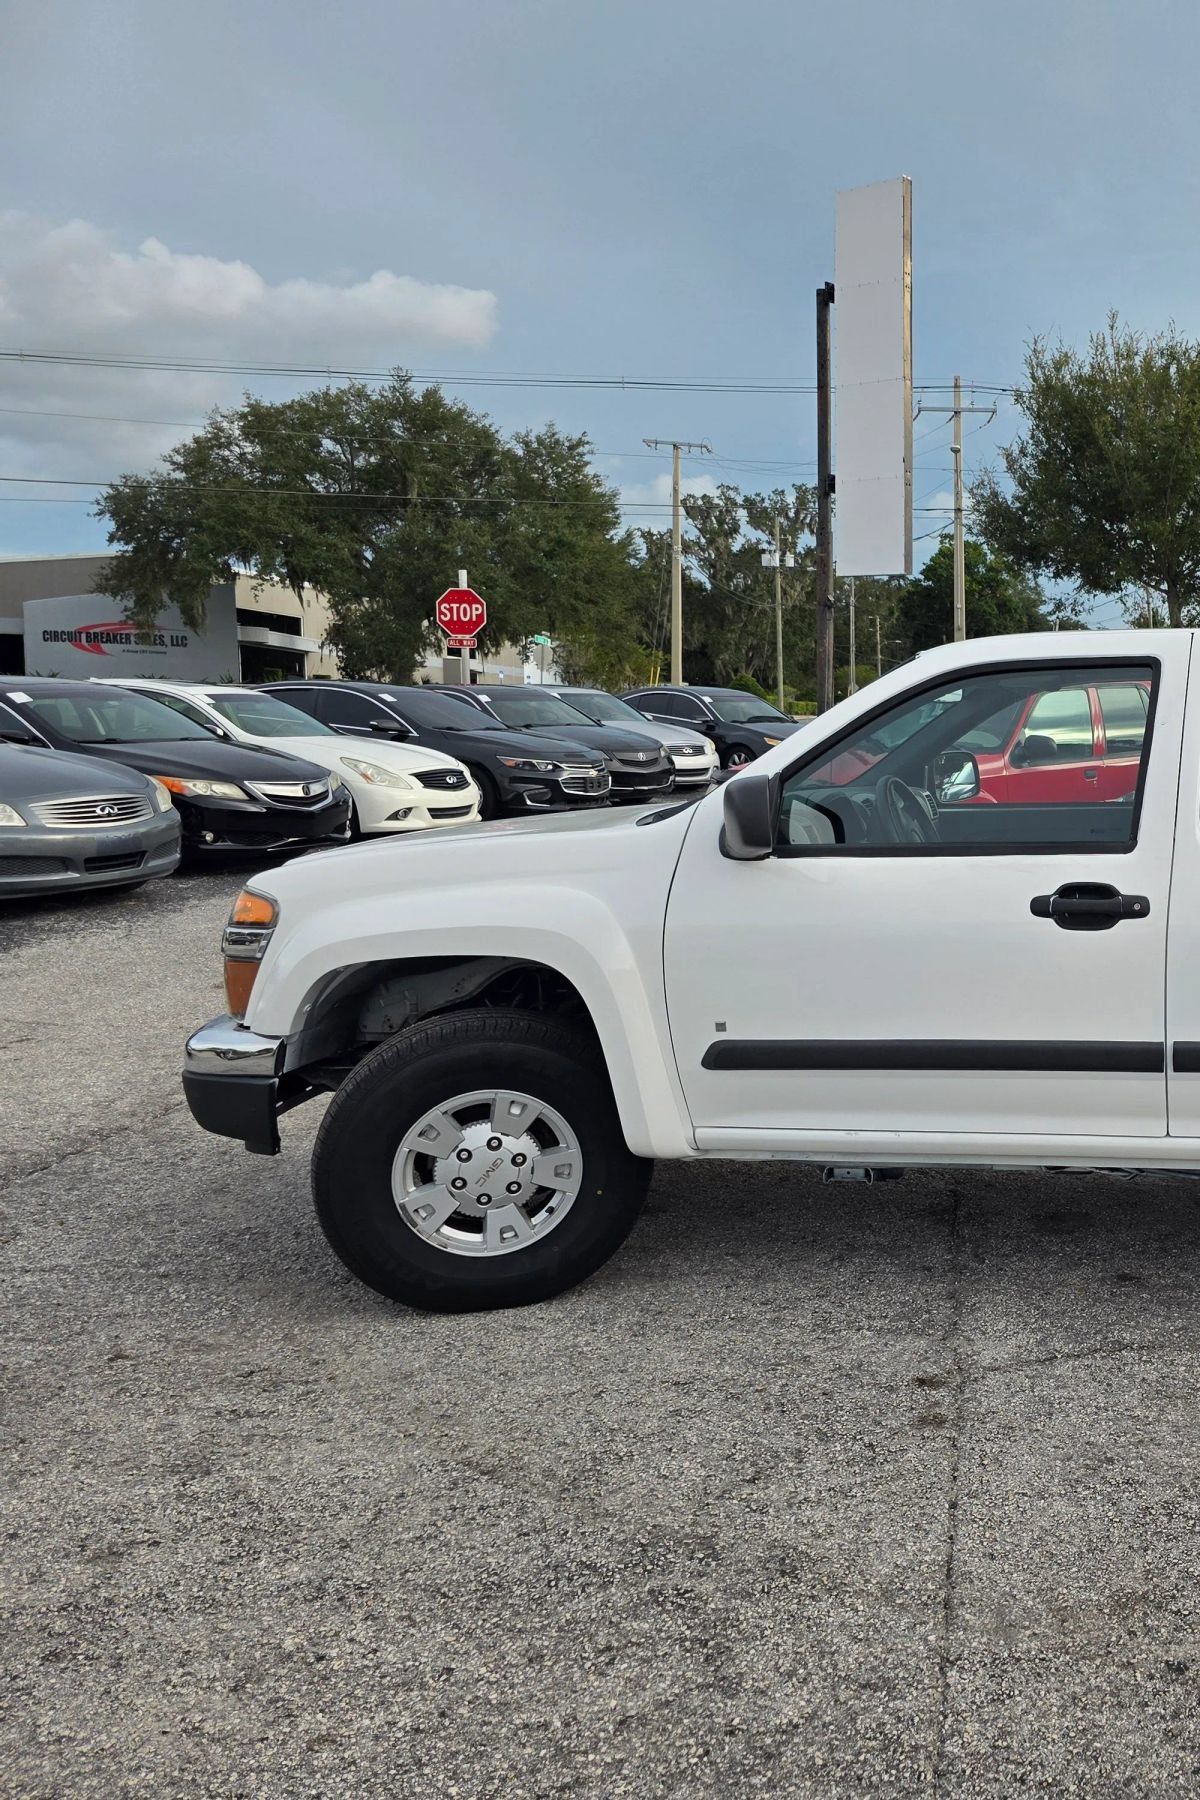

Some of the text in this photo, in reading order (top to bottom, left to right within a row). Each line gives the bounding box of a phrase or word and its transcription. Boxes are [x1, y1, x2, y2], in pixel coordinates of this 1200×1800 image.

[440, 603, 483, 622] STOP
[42, 630, 83, 643] CIRCUIT
[85, 632, 131, 645] BREAKER
[171, 634, 188, 648] LLC
[474, 1157, 504, 1188] GMC
